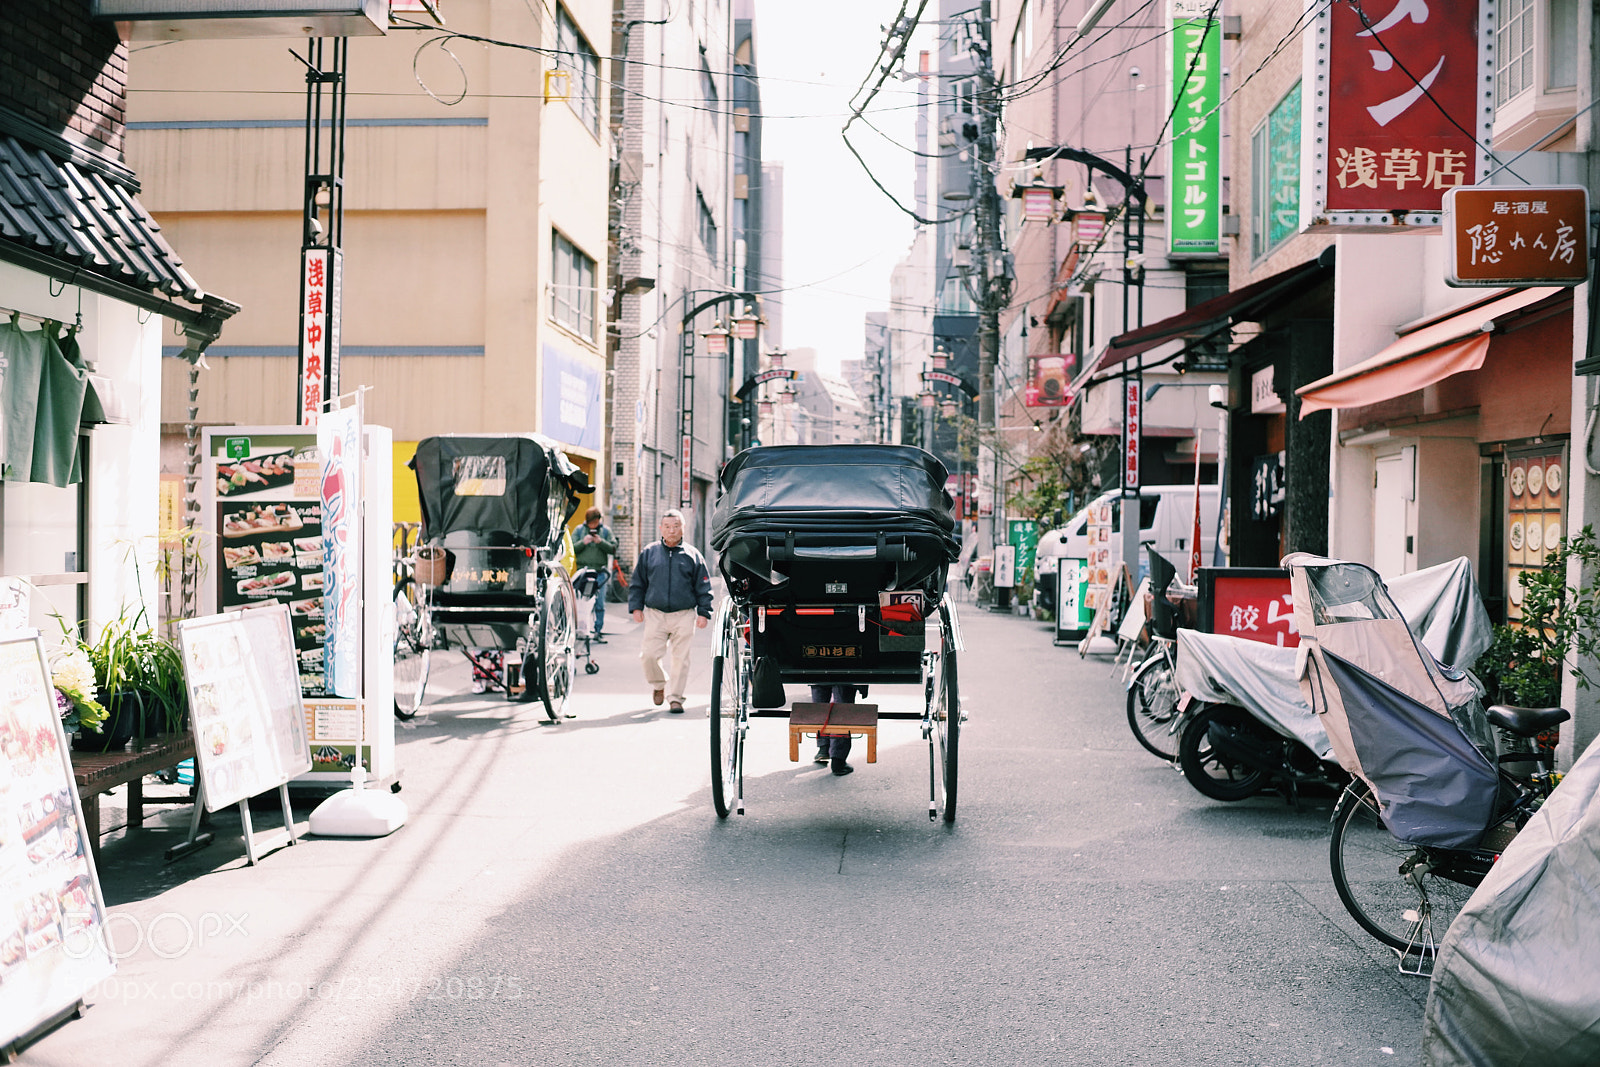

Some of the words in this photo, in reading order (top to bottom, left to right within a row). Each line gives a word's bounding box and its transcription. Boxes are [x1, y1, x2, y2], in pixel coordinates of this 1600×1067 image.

[1336, 147, 1467, 190] 浅草店
[1492, 201, 1550, 215] 居酒屋
[1465, 219, 1577, 266] 隠れん房
